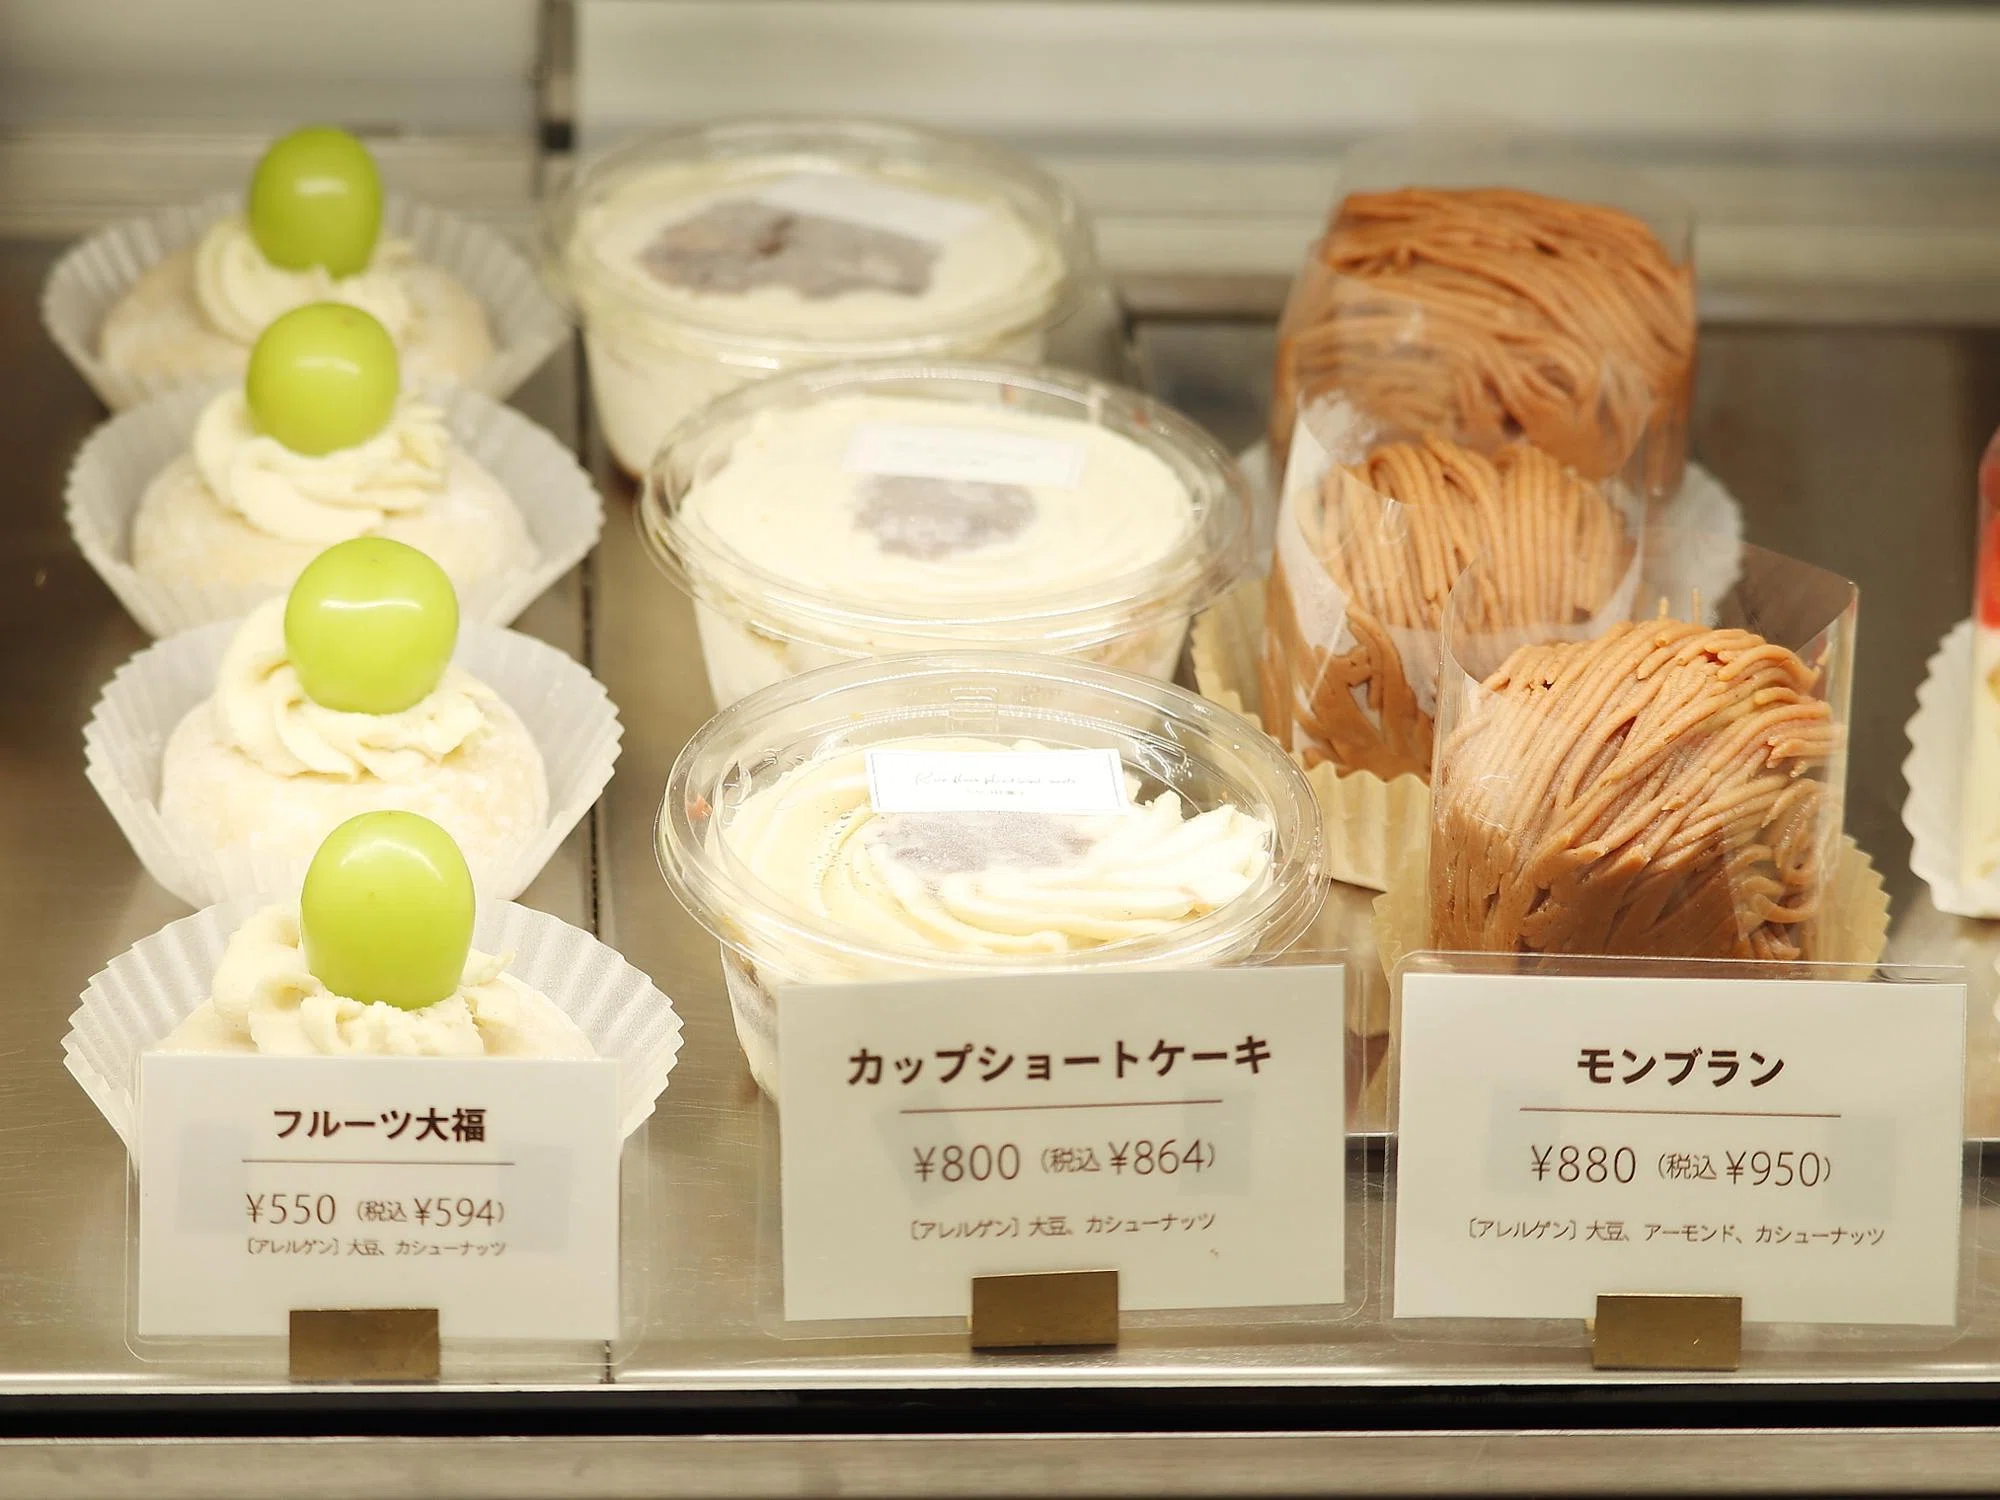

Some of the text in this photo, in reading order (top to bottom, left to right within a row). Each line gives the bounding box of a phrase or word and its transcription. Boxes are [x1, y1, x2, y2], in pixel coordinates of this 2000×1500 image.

[846, 1034, 1273, 1087] カップショートケーキ
[1576, 1045, 1785, 1087] モンブラン
[273, 1106, 487, 1143] フルーツ大福
[912, 1142, 1021, 1184] ¥800
[1530, 1143, 1637, 1185] ¥880
[245, 1191, 337, 1226] ¥550
